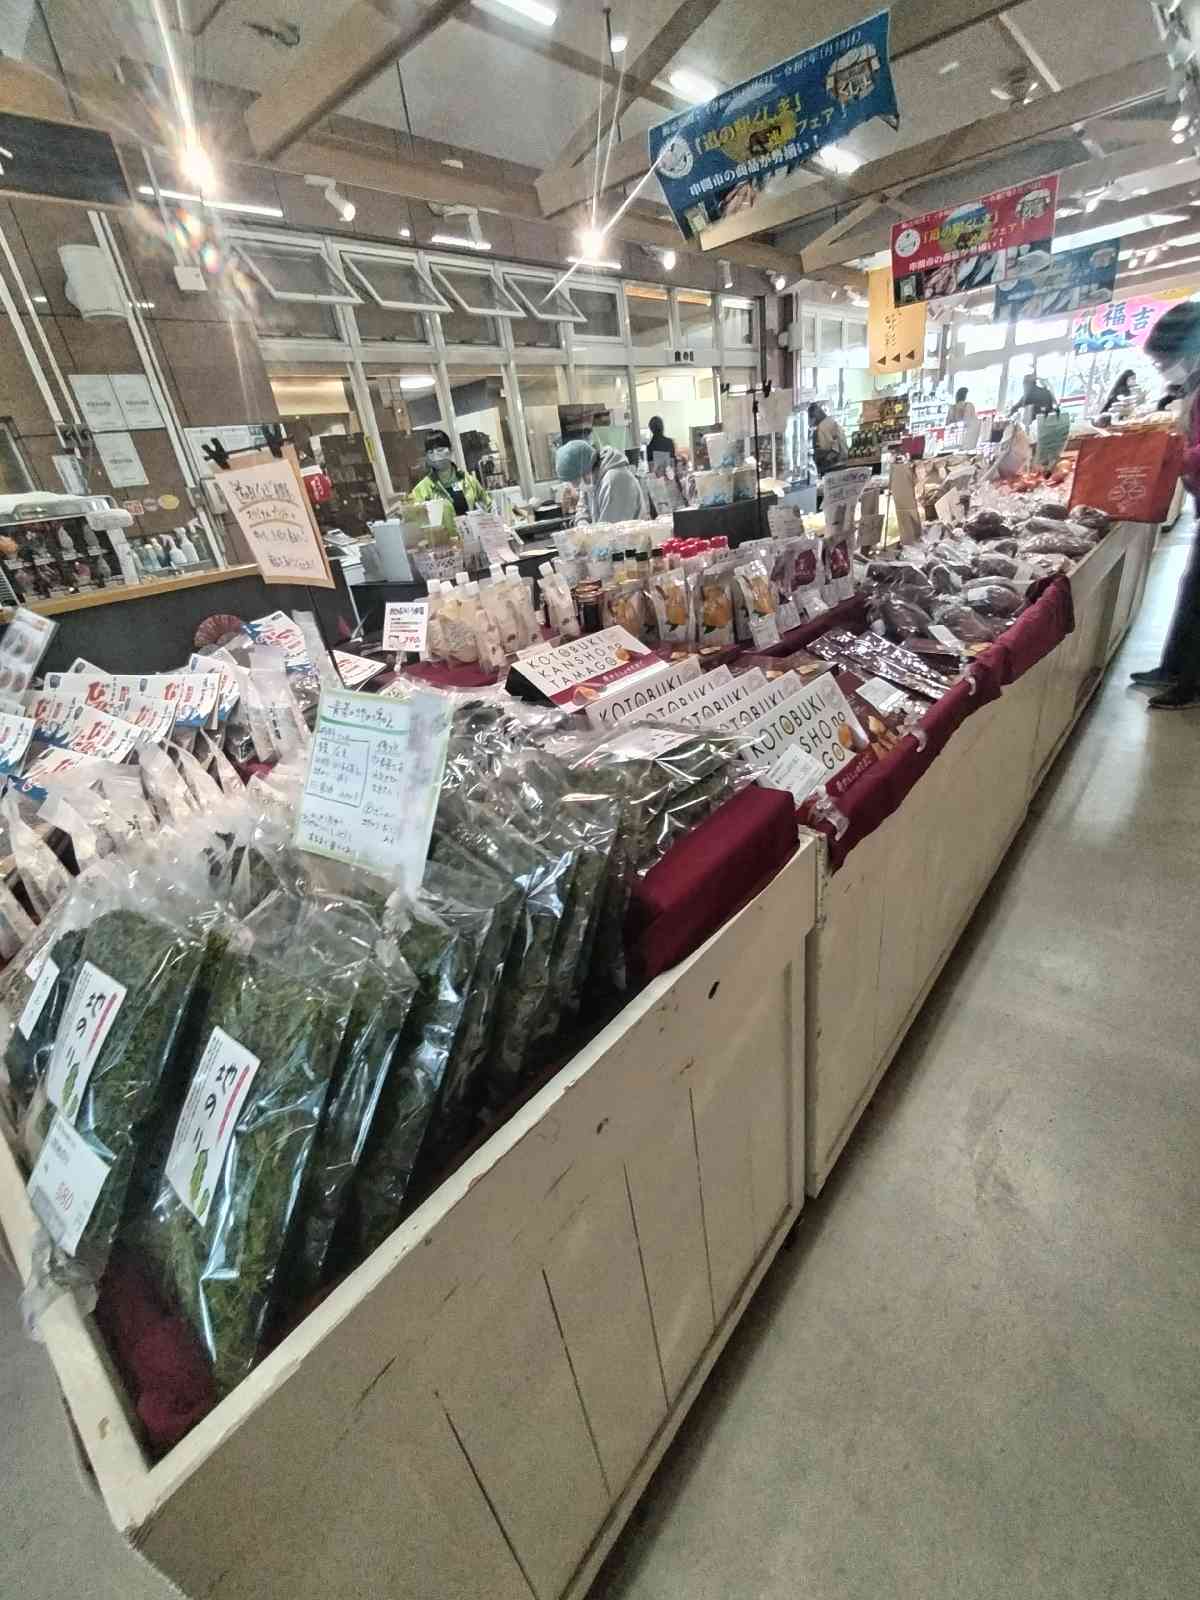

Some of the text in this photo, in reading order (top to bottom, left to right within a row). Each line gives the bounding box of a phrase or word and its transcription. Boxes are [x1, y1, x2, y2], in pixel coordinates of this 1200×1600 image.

[527, 633, 605, 669] KOTOBUKI
[550, 656, 617, 688] TAMAGO
[750, 693, 826, 758] KOTOBUKI
